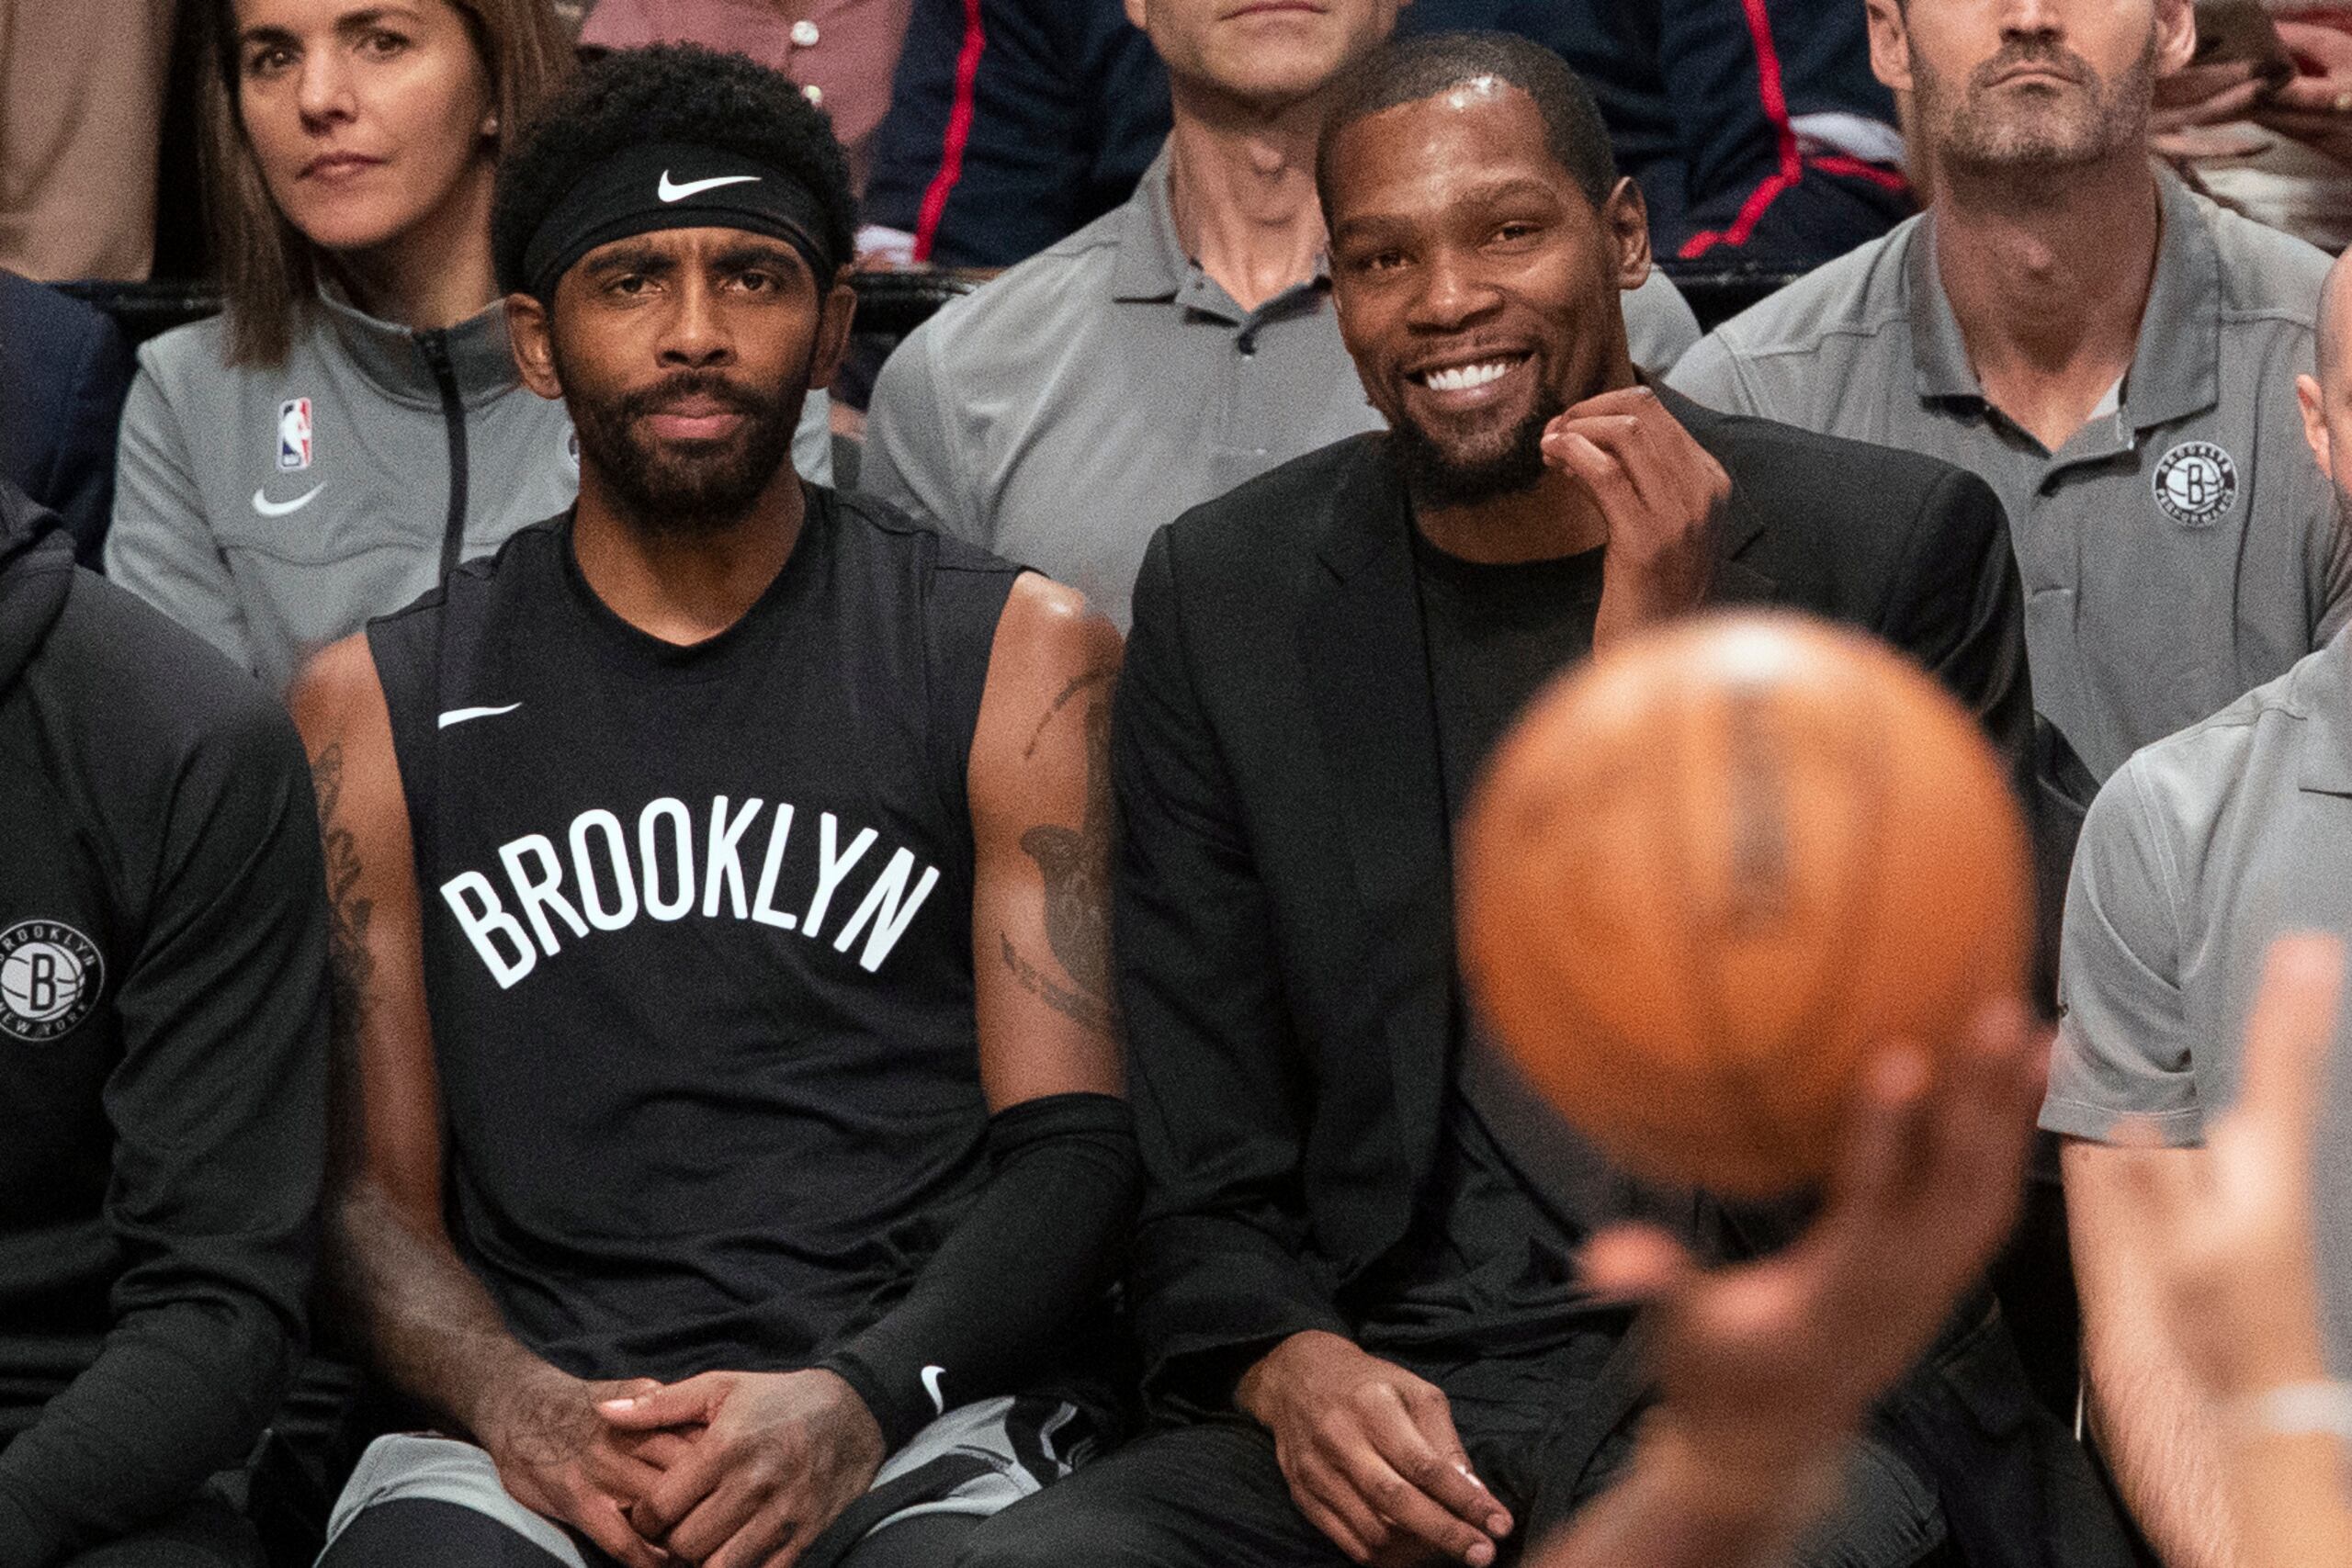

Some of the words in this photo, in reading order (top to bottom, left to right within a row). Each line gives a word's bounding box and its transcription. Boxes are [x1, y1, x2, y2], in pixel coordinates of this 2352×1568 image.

[2188, 463, 2204, 504] B
[439, 795, 940, 989] BROOKLYN
[30, 953, 56, 1011] B
